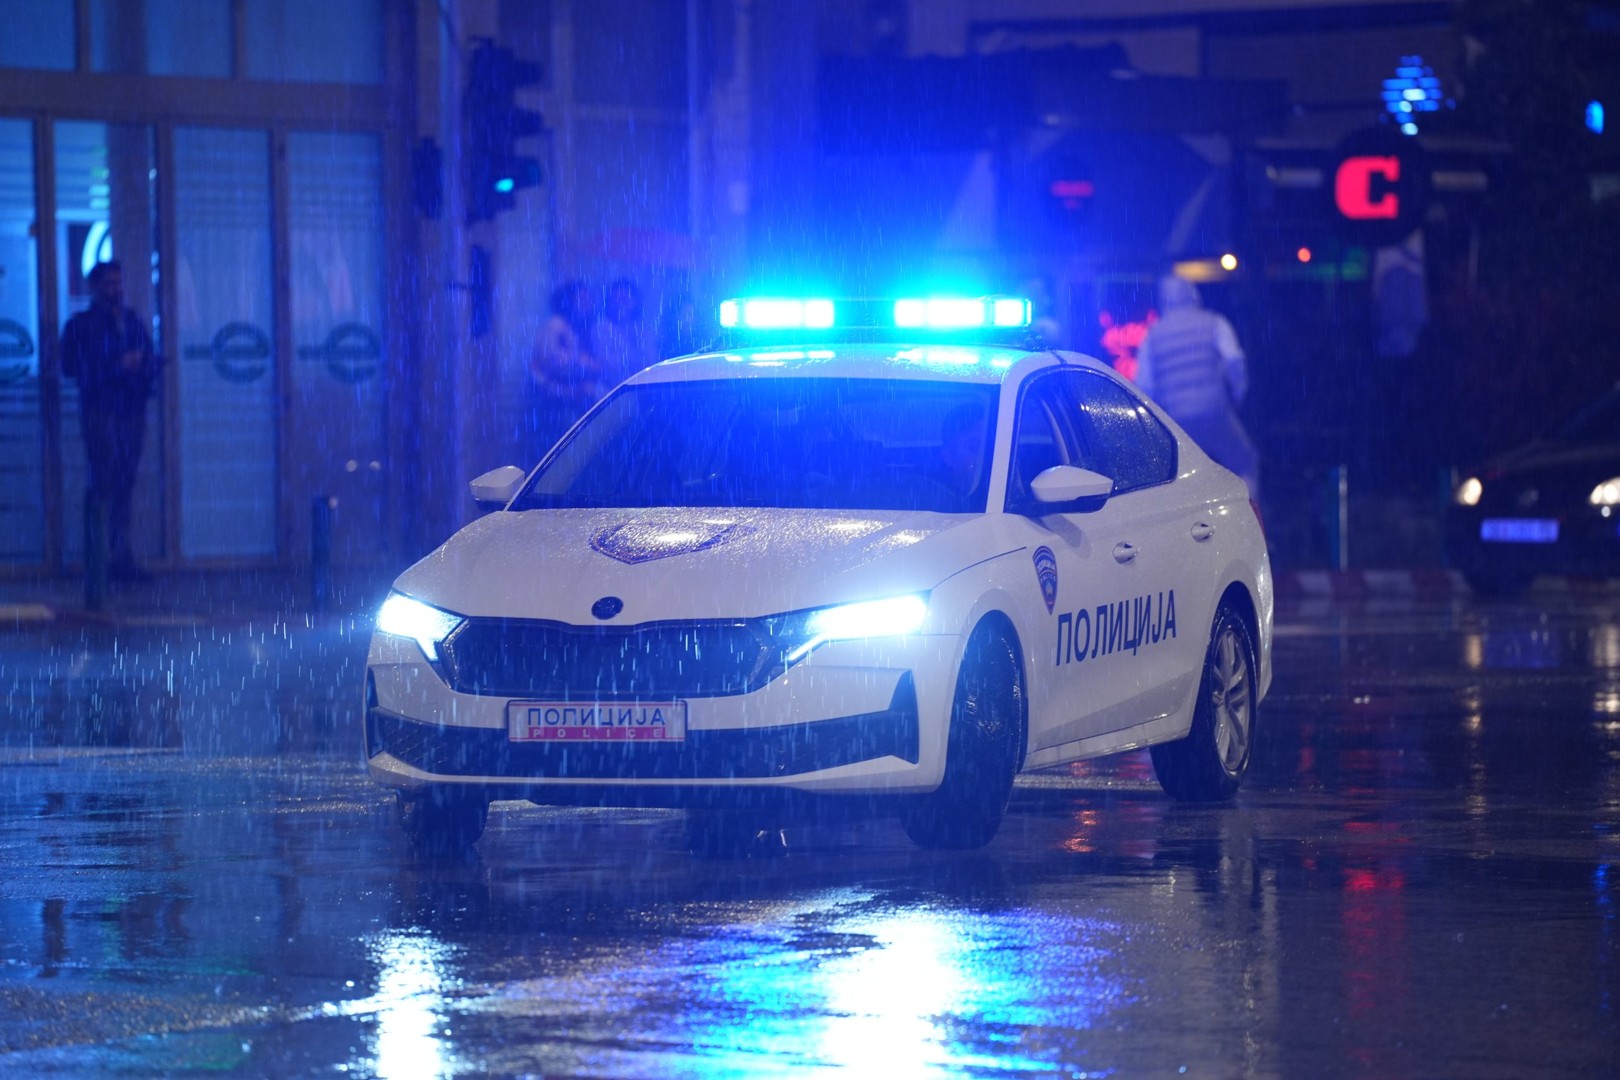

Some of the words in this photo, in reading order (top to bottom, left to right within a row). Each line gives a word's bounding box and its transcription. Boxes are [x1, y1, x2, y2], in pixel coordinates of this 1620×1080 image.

[1056, 589, 1176, 666] ПОЛИЦИЈА
[528, 707, 665, 727] ПОЛИЦИЈА
[533, 729, 662, 738] POLICE
